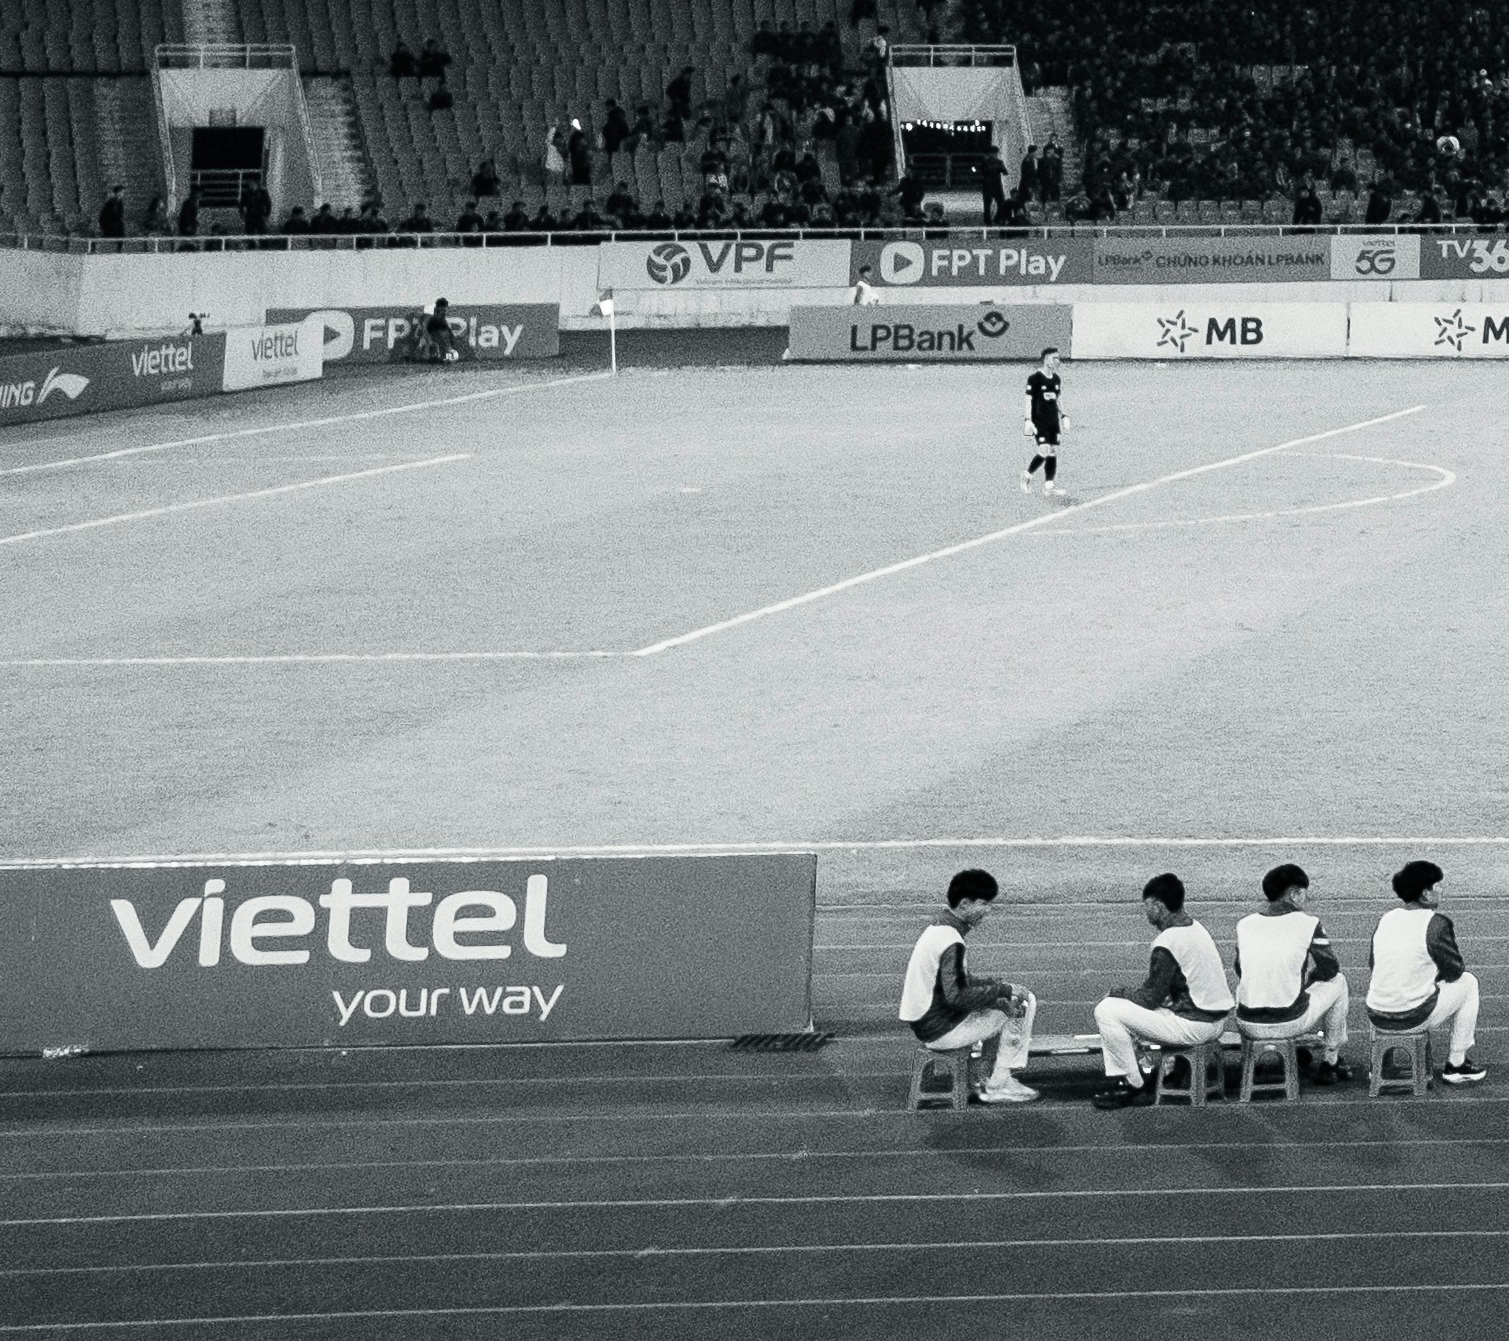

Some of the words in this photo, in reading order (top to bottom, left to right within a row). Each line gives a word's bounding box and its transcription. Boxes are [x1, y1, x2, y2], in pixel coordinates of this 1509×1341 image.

[696, 241, 794, 274] VPF
[931, 248, 993, 277] FPT
[1000, 247, 1066, 282] Play
[1355, 249, 1396, 275] 5G
[251, 330, 298, 361] viettel
[850, 323, 976, 352] LPBank
[1205, 317, 1264, 346] MB
[132, 342, 193, 377] viettel
[110, 874, 567, 969] viettel
[332, 987, 450, 1026] your
[461, 983, 564, 1021] way
